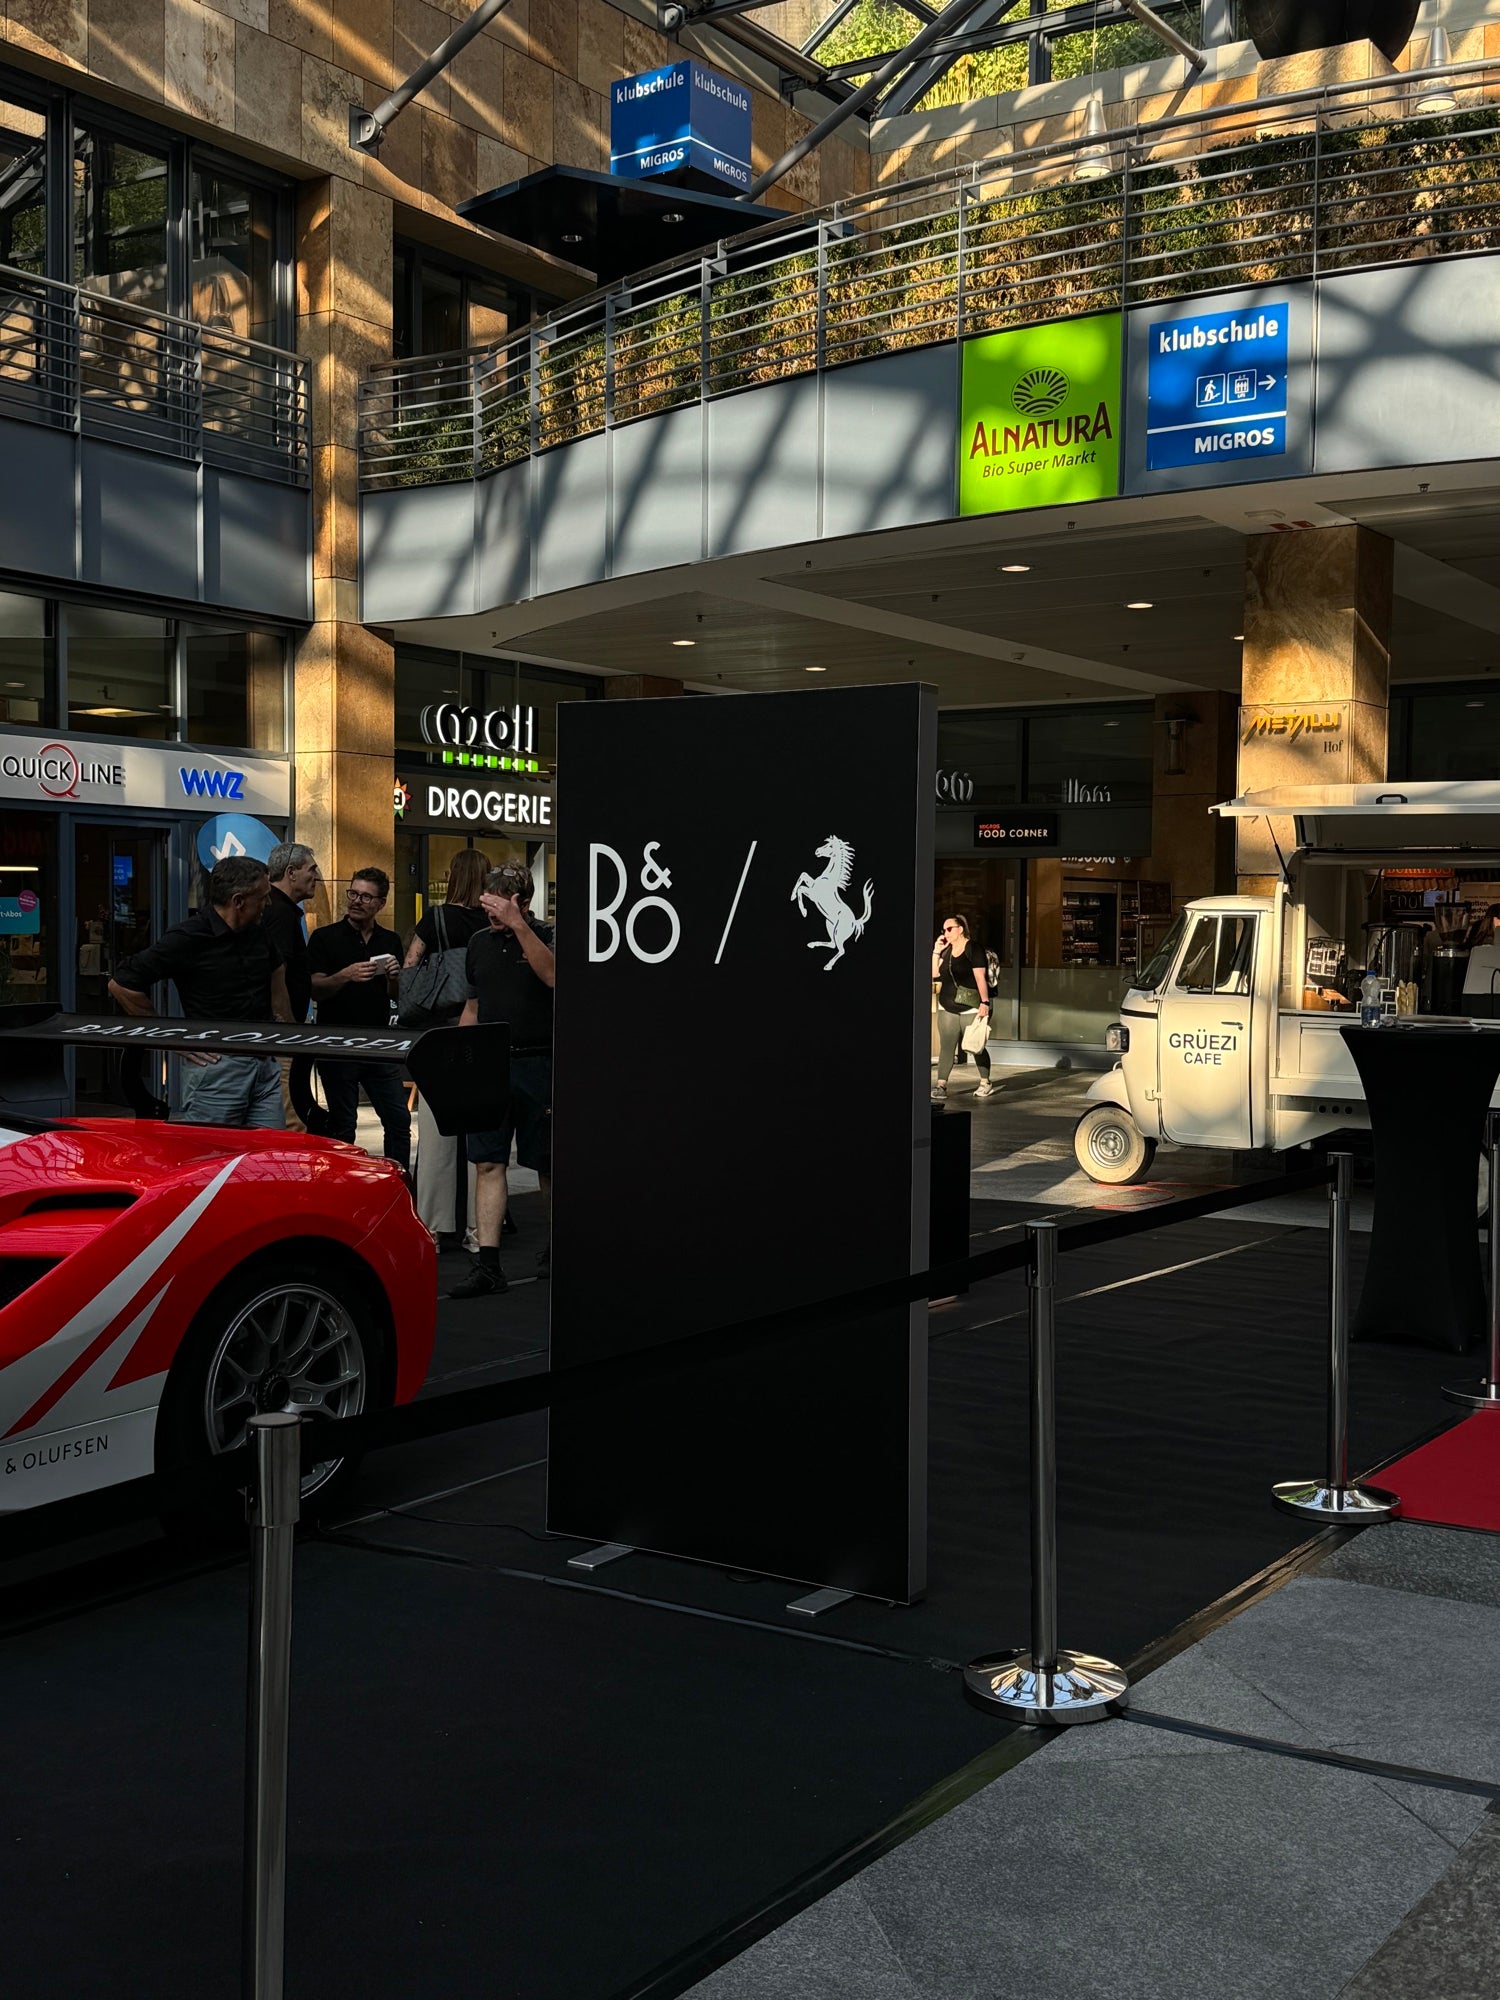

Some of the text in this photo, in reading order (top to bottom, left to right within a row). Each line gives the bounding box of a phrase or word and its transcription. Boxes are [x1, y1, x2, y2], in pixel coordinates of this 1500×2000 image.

[616, 71, 684, 104] klubschule
[694, 70, 748, 111] klubschule
[640, 147, 685, 170] MIGROS
[713, 157, 747, 183] MIGROS
[1159, 315, 1279, 354] klubschule
[969, 401, 1113, 460] ALNATURA
[1193, 427, 1275, 454] MIGROS
[982, 450, 1097, 478] Bio Super Markt
[436, 703, 539, 754] moll
[1323, 739, 1344, 753] Hof
[178, 767, 244, 799] WWZ
[428, 785, 551, 825] DROGERIE
[978, 828, 1048, 838] FOOD CORNER
[61, 1023, 412, 1051] BANG & OLUFSEN
[1169, 1029, 1237, 1051] GRÜEZI
[1184, 1052, 1222, 1065] CAFE
[5, 1434, 109, 1475] & OLUFSEN
